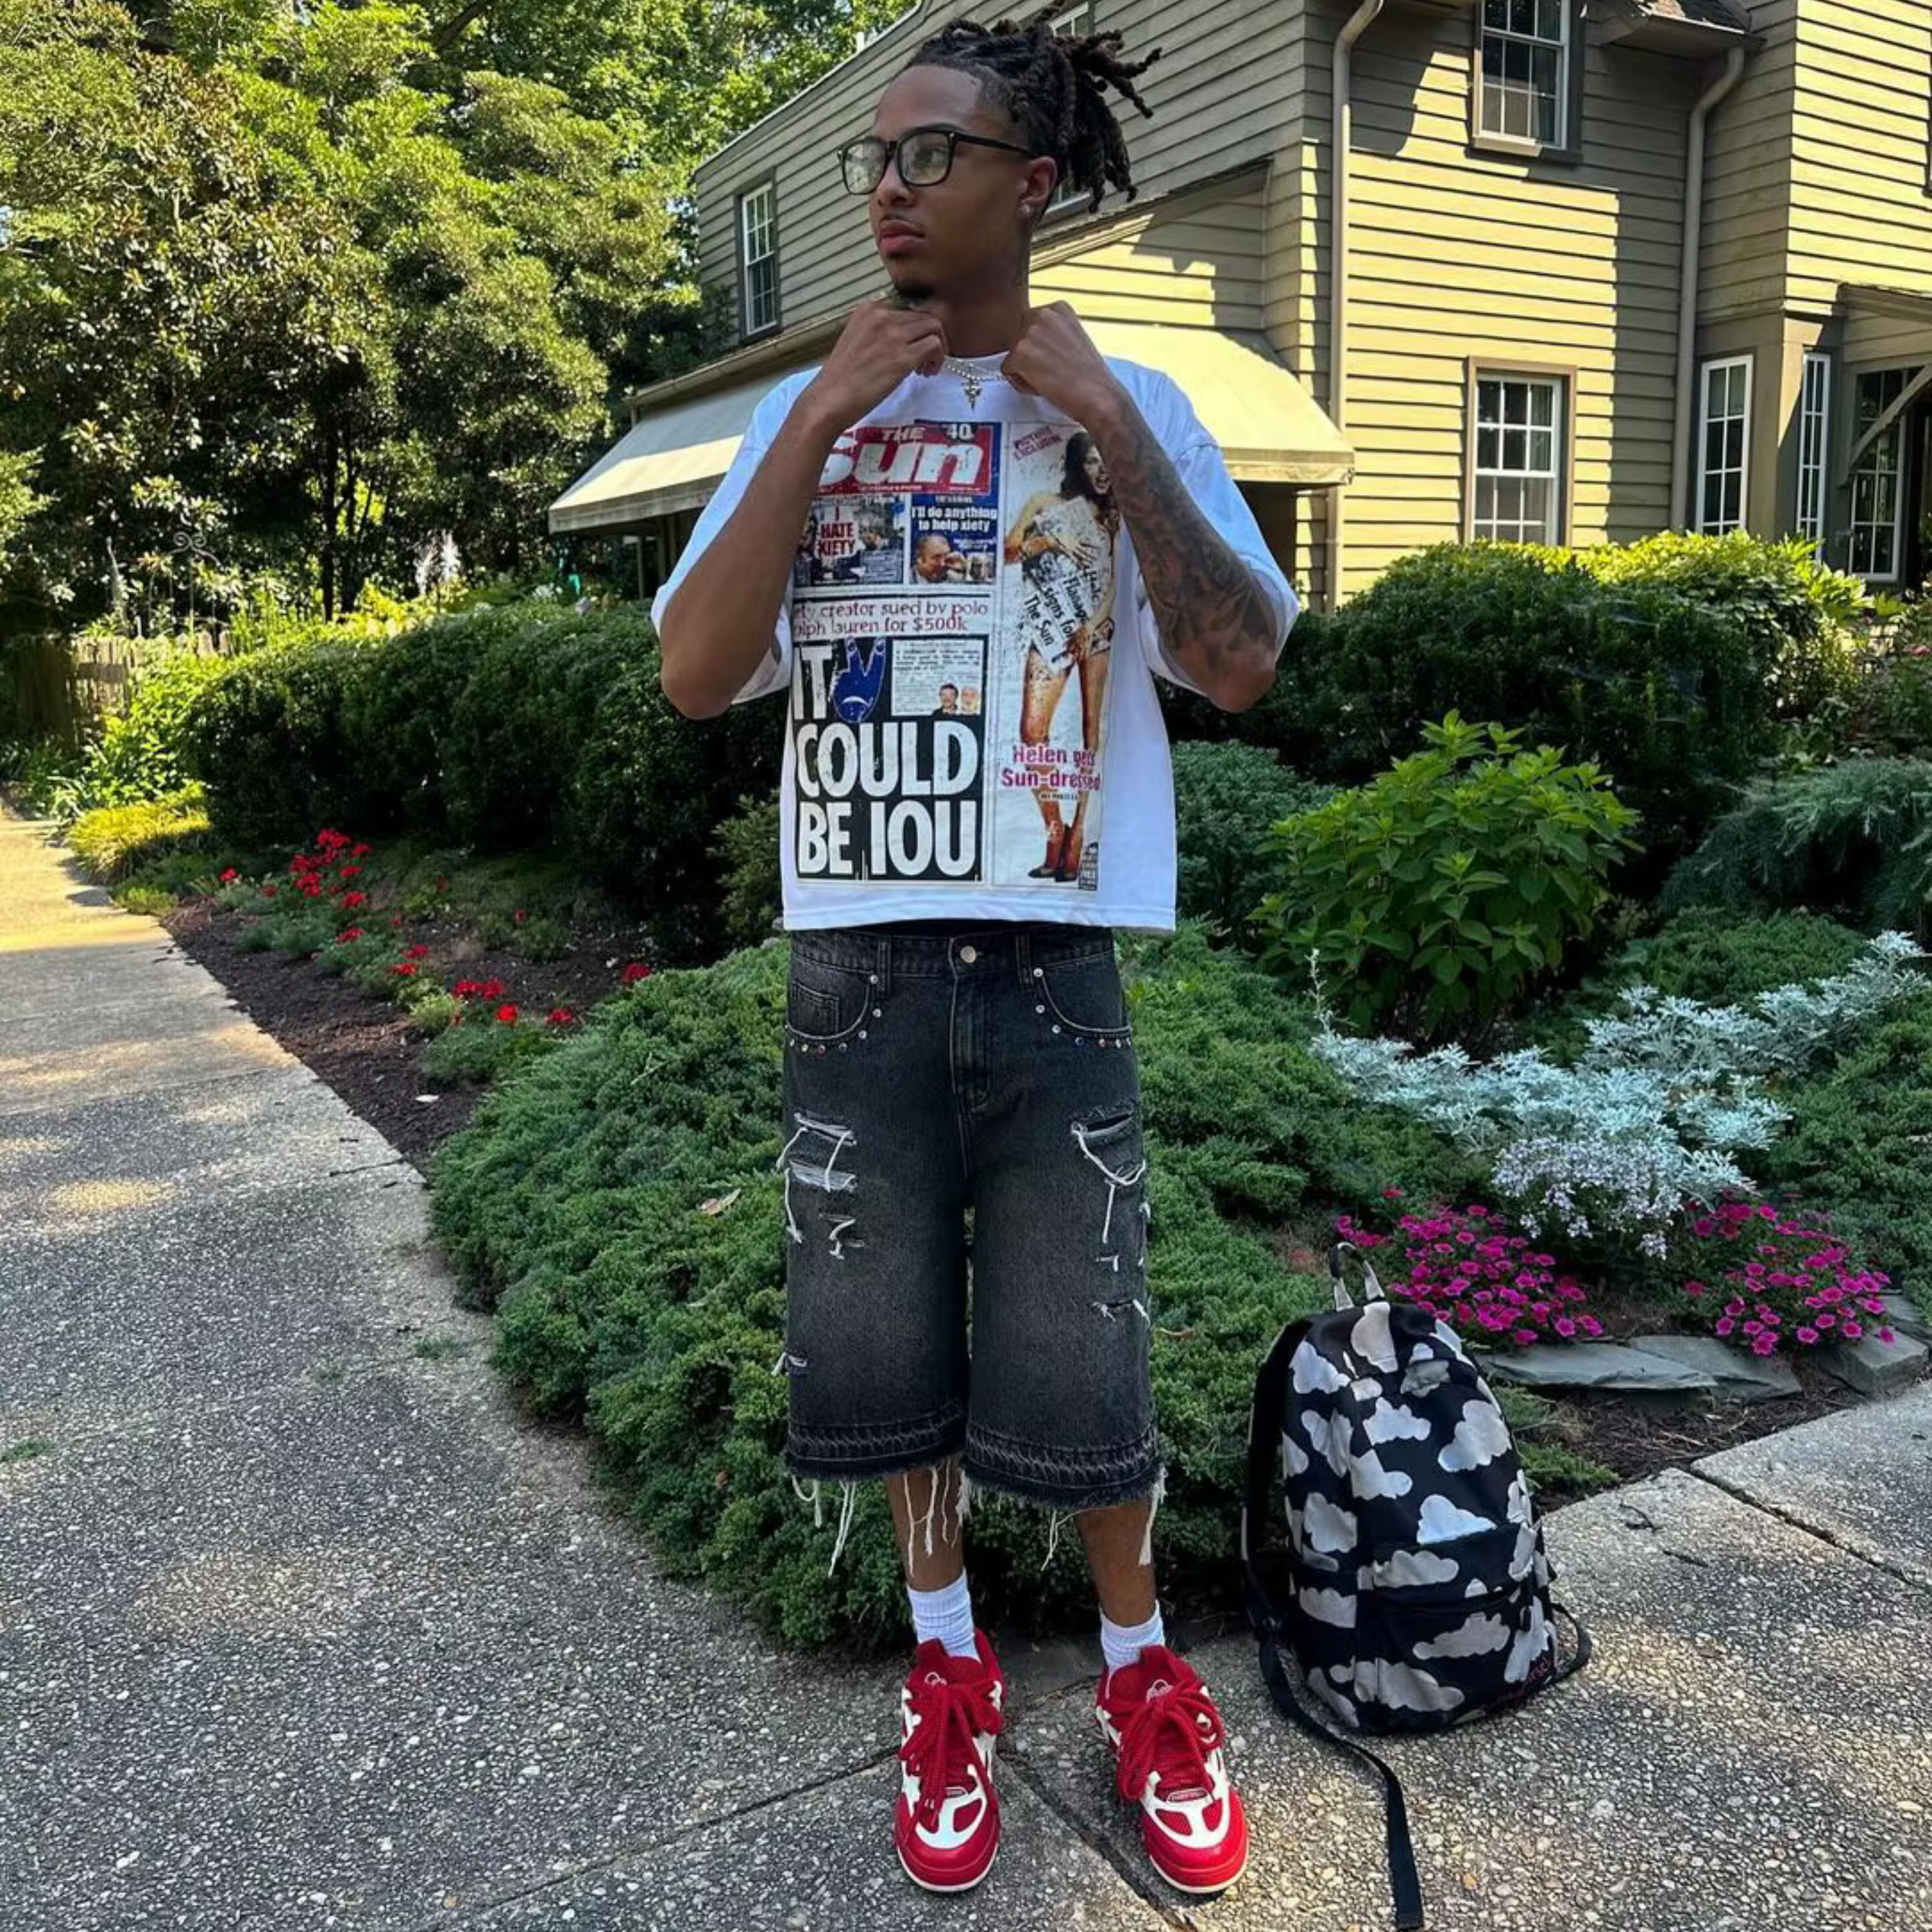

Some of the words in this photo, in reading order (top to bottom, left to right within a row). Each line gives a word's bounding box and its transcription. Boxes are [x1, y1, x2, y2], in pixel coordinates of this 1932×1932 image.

[882, 426, 926, 442] THE
[927, 505, 943, 517] do
[944, 506, 997, 520] anything
[820, 522, 854, 539] HATE
[919, 519, 930, 531] to
[931, 519, 958, 532] help
[820, 602, 876, 618] creator
[881, 600, 922, 616] sued
[951, 600, 988, 619] polo
[831, 618, 879, 635] lauren
[884, 617, 907, 632] for
[912, 615, 967, 631] $500k
[1036, 620, 1055, 646] Sun
[793, 645, 833, 720] IT
[796, 720, 979, 798] COULD
[1012, 745, 1067, 764] Helen
[799, 801, 854, 875] BE
[870, 800, 977, 877] IOU
